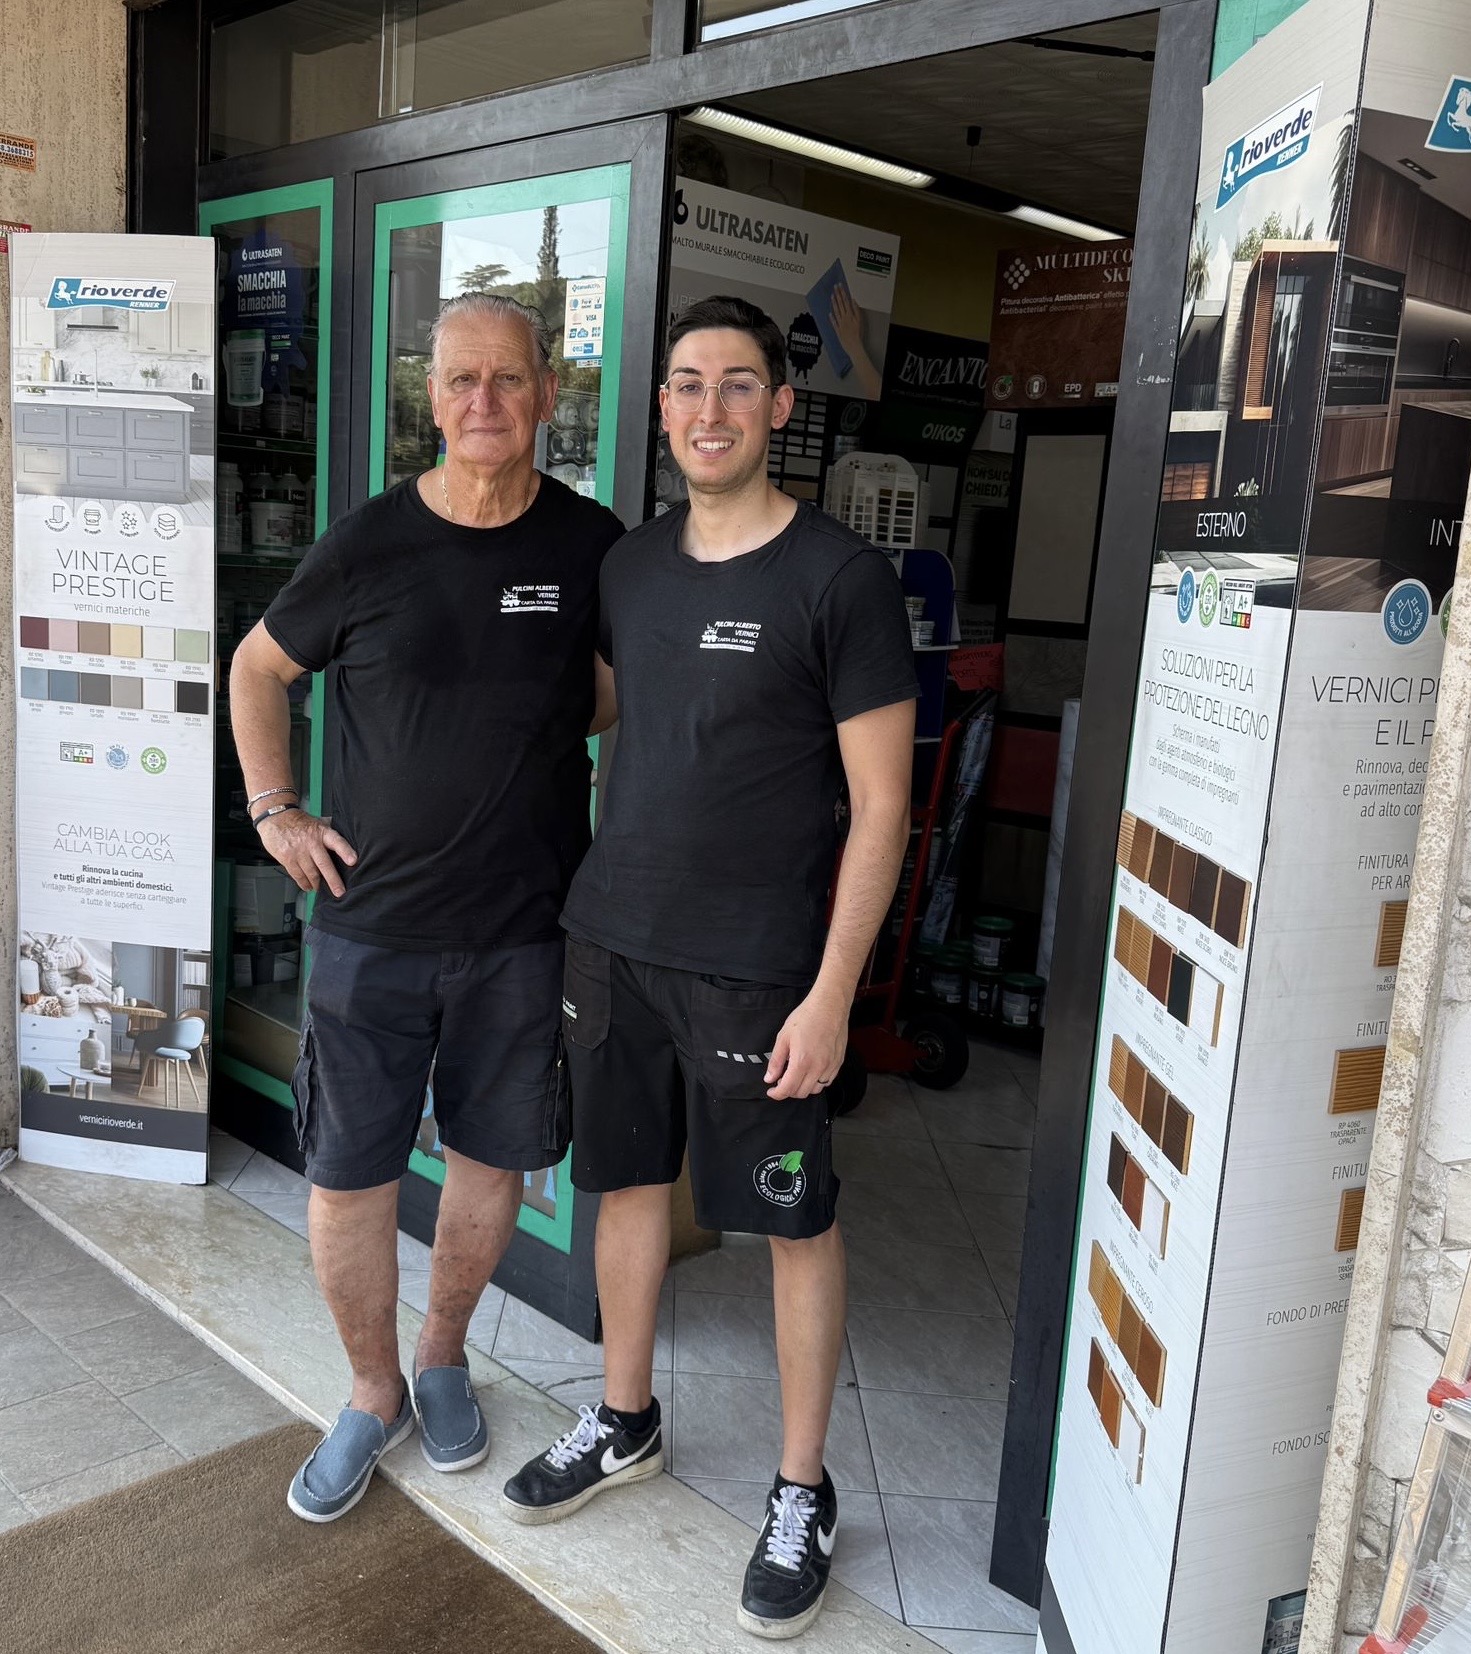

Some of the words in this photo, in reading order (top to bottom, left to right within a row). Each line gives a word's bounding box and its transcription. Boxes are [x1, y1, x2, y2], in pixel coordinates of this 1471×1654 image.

[1241, 107, 1313, 169] rioverde
[696, 205, 809, 255] ULTRASATEN
[248, 247, 283, 260] ULTRASATEN
[695, 241, 722, 256] MURALE
[723, 249, 769, 267] SMACCHIABILE
[770, 259, 805, 275] ECOLOGICO
[237, 269, 287, 293] SMACCHIA
[81, 284, 168, 300] rioverde
[237, 294, 246, 312] la
[247, 290, 287, 312] macchia
[129, 301, 161, 309] RENNER
[790, 331, 819, 345] SMACCHIA
[1064, 383, 1082, 394] EPD
[999, 415, 1012, 430] La
[921, 422, 967, 443] OIKOS
[966, 481, 1003, 498] CHIEDI
[1196, 511, 1247, 538] ESTERNO
[57, 548, 167, 577] VINTAGE
[52, 573, 174, 602] PRESTIGE
[74, 603, 104, 614] vernici
[105, 604, 151, 617] materiche
[734, 621, 762, 631] ALBERTO
[1161, 648, 1214, 683] SOLUZIONI
[1214, 660, 1239, 687] PER
[1239, 665, 1254, 694] LA
[1312, 676, 1413, 704] VERNICI
[1144, 680, 1203, 719] PROTEZIONE
[1203, 697, 1225, 727] DEL
[1226, 704, 1270, 741] LEGNO
[1375, 719, 1392, 745] E
[1396, 720, 1415, 745] IL
[1355, 758, 1404, 775] Rinnova,
[1342, 783, 1350, 796] e
[1360, 802, 1375, 817] ad
[1378, 801, 1400, 817] alto
[57, 823, 120, 842] CAMBIA
[125, 830, 171, 847] LOOK
[53, 838, 92, 855] ALLA
[94, 842, 128, 857] TUA
[131, 846, 175, 862] CASA
[82, 865, 111, 875] Rinnova
[112, 867, 119, 876] la
[120, 869, 144, 878] cucina
[1358, 854, 1409, 870] FINITURA
[59, 873, 75, 882] tutti
[76, 875, 85, 884] gli
[86, 876, 101, 885] altri
[102, 878, 134, 889] ambienti
[136, 881, 174, 892] domestici.
[1371, 876, 1392, 891] PER
[42, 881, 66, 892] Vintage
[67, 884, 94, 895] Prestige
[95, 887, 125, 898] aderisce
[126, 891, 146, 901] senza
[147, 893, 187, 905] carteggiare
[86, 897, 103, 906] tutte
[104, 899, 112, 907] le
[112, 900, 145, 911] superfici.
[79, 1114, 143, 1130] vernicirioverde.it
[1330, 1127, 1367, 1138] TRASPARENTE
[1332, 1162, 1367, 1180] FINITU
[760, 1184, 796, 1203] ECOLOGICAL
[793, 1176, 803, 1197] PAINT
[1267, 1306, 1307, 1326] FONDO
[1310, 1304, 1321, 1318] DI
[1272, 1435, 1311, 1455] FONDO
